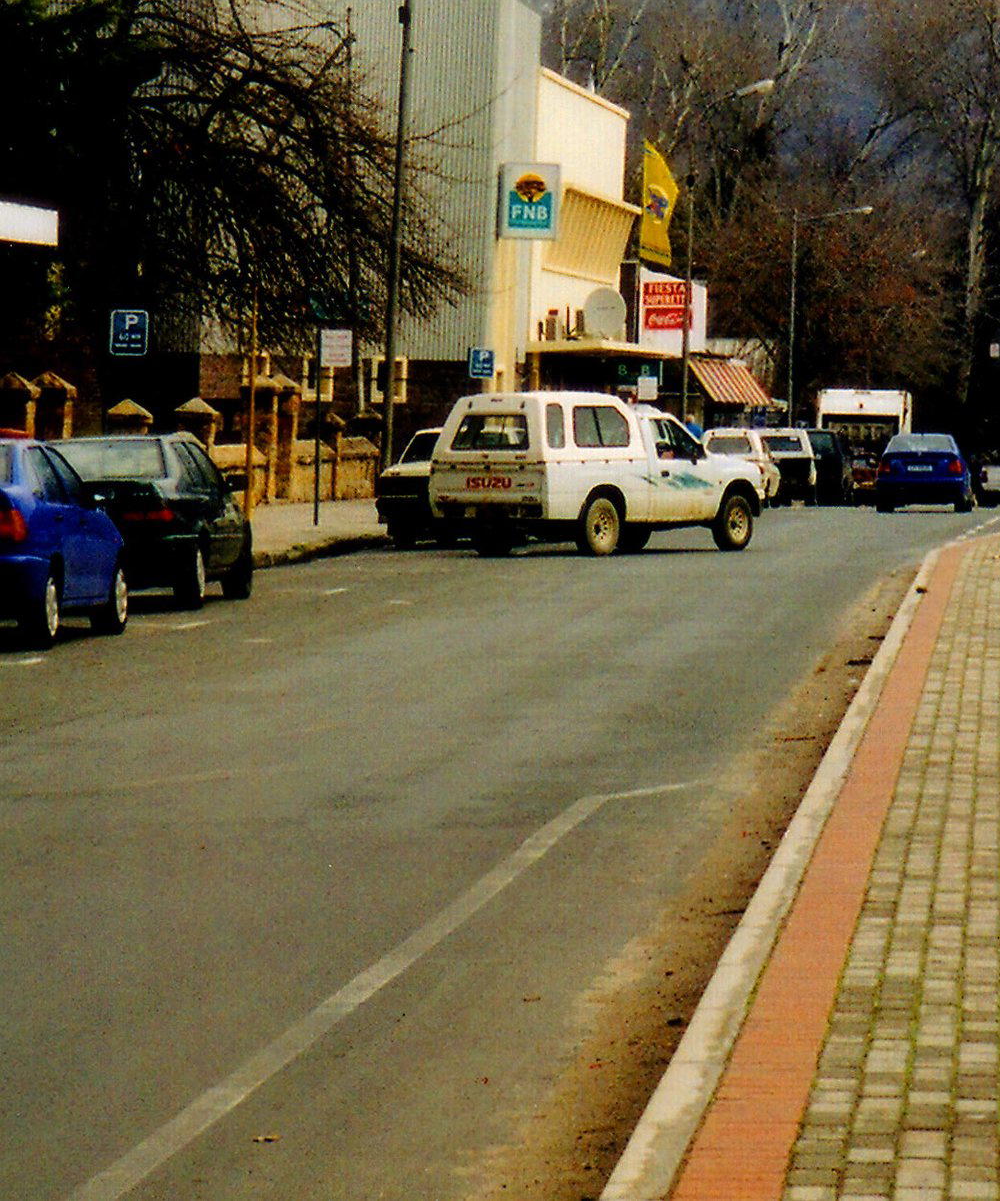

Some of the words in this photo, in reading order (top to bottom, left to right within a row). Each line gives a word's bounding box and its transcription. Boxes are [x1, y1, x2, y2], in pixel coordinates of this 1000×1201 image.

[511, 204, 548, 220] FNB
[647, 283, 687, 294] FIESTA
[125, 314, 139, 330] P
[466, 477, 512, 489] ISUZU
